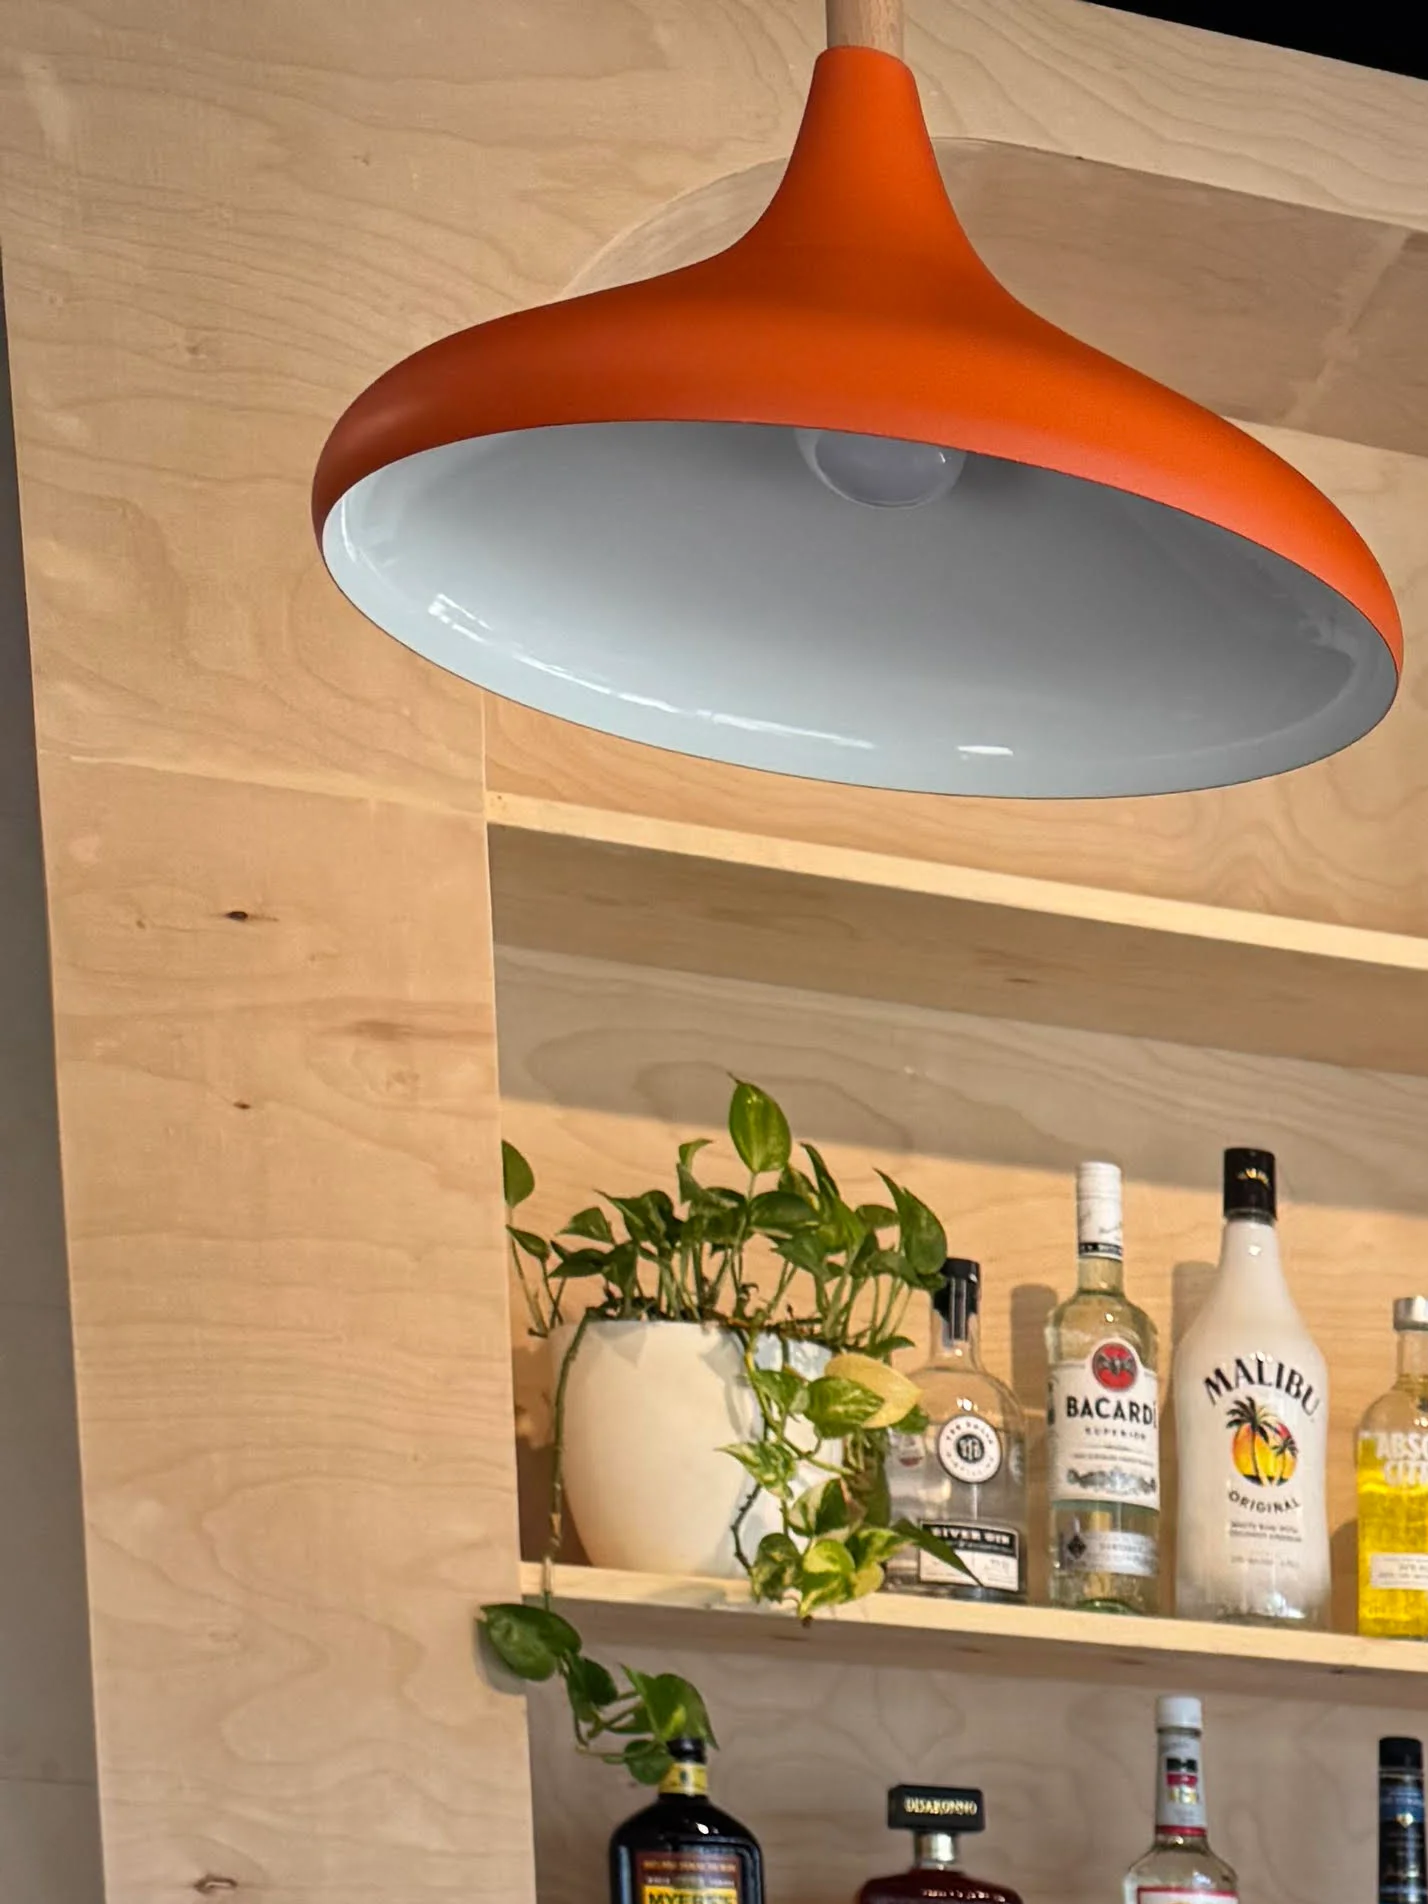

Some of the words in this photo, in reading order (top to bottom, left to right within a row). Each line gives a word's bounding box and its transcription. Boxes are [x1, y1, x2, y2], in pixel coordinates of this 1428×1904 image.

[1204, 1353, 1321, 1416] MALIBU
[1084, 1426, 1147, 1440] SUPERIOR
[1228, 1490, 1301, 1514] ORIGINAL
[904, 1797, 978, 1816] DISARONNO
